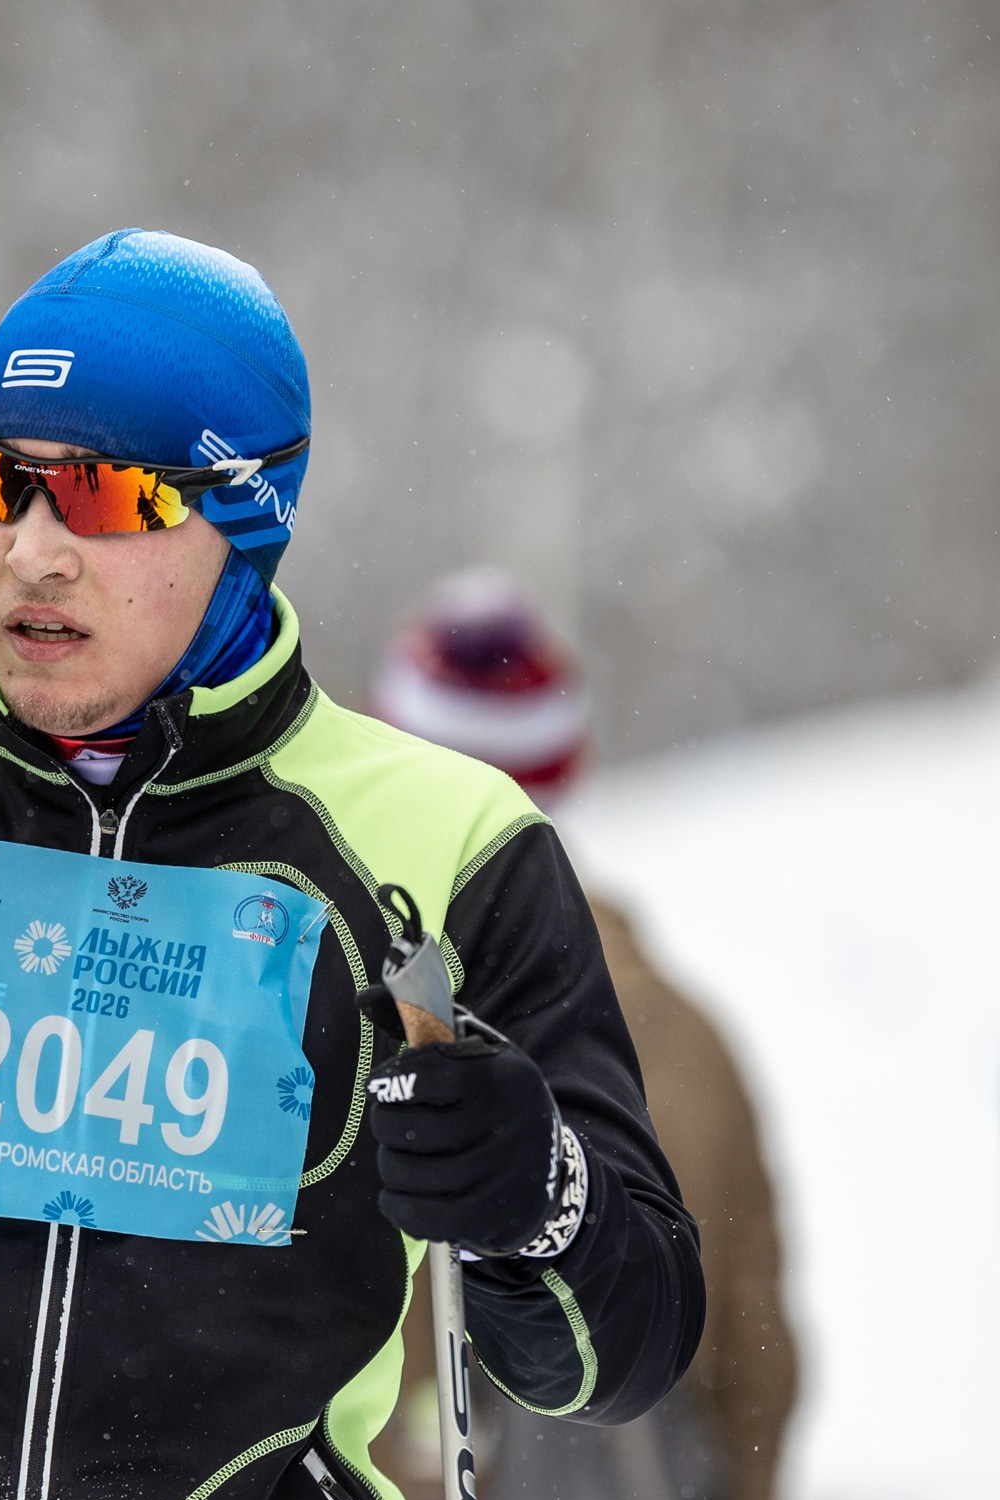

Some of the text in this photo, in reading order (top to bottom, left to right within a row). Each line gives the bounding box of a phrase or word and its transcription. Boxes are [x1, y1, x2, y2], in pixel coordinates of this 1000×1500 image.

[78, 927, 207, 973] ЛЫЖНЯ
[72, 955, 202, 999] РОССИИ
[71, 988, 130, 1019] 2026
[109, 1164, 213, 1194] ОБЛАСТЬ
